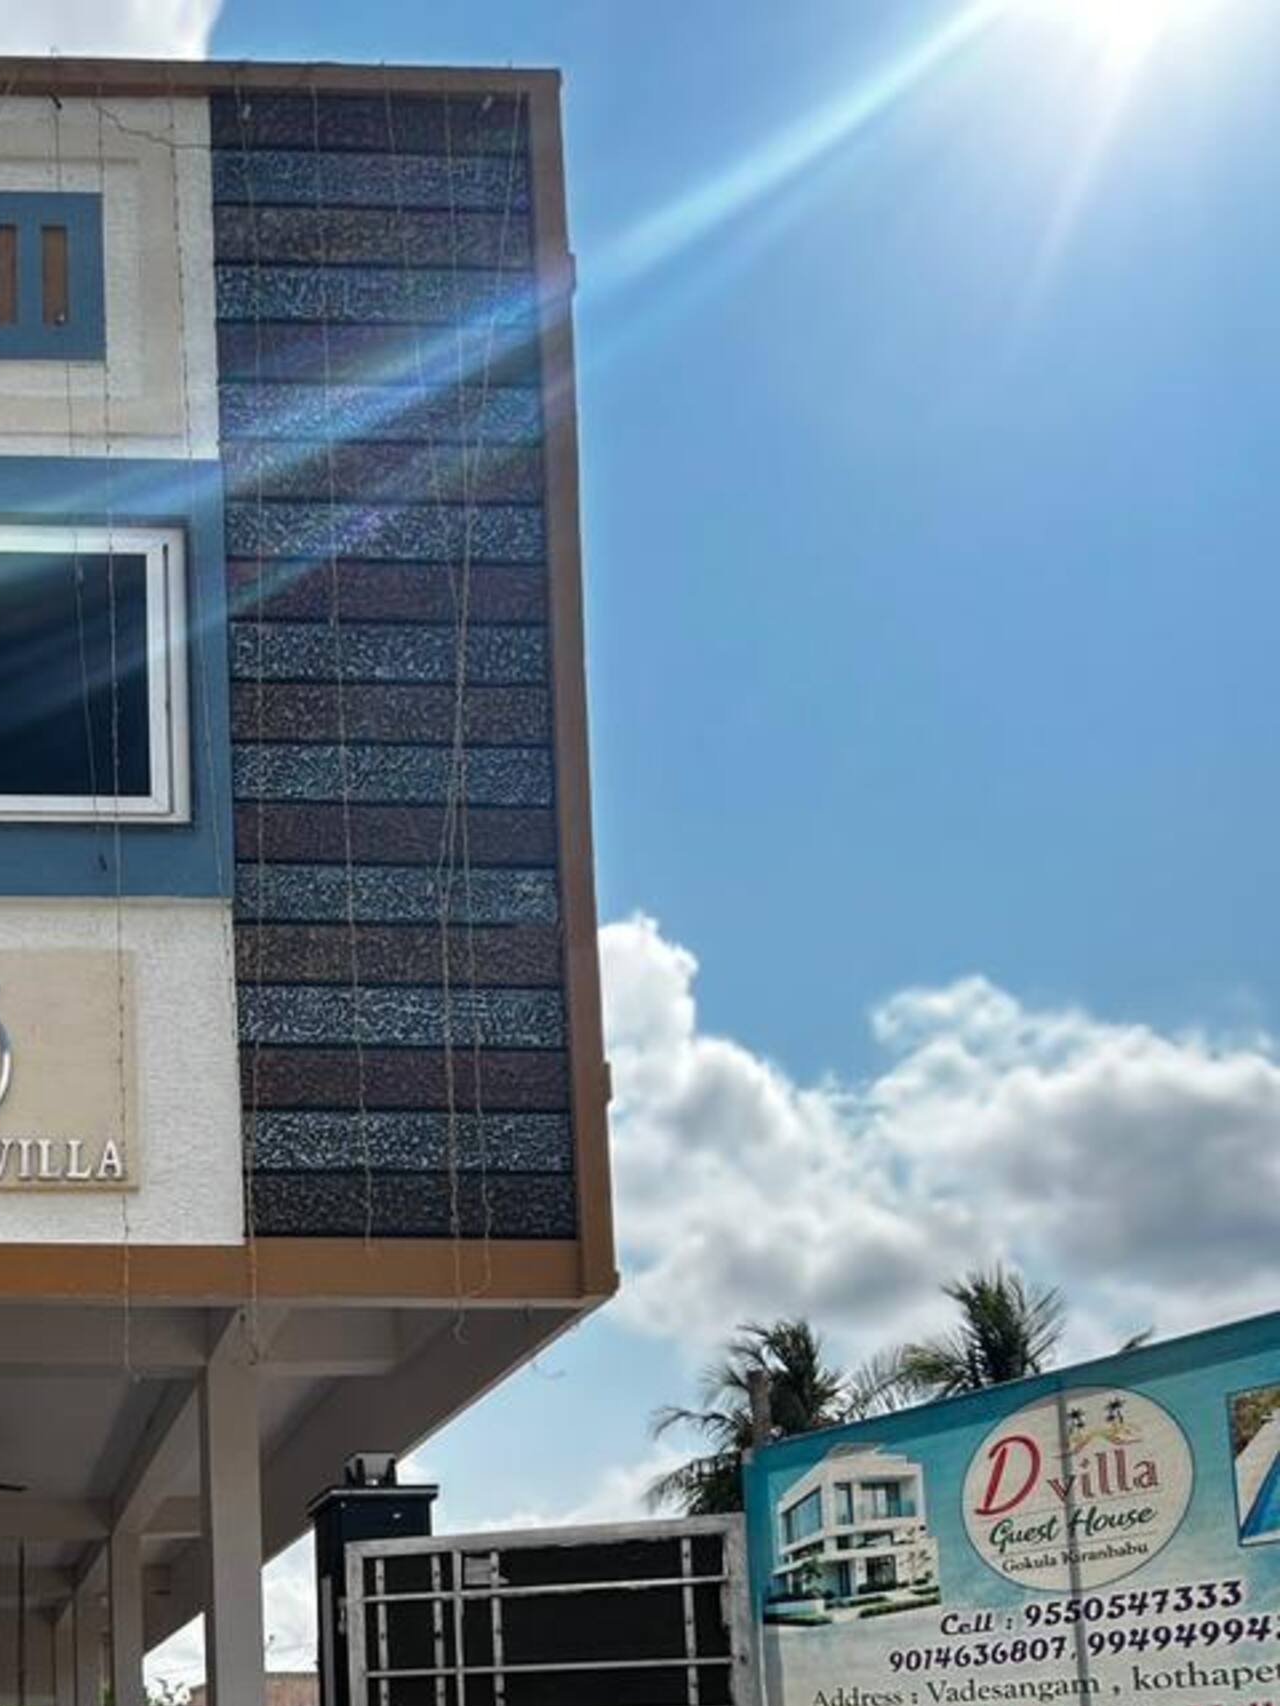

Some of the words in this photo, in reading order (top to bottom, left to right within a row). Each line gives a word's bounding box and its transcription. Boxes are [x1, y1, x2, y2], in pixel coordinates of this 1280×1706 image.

[974, 1435, 1041, 1515] D
[1047, 1449, 1159, 1501] villa
[989, 1515, 1058, 1554] Guest
[1068, 1506, 1154, 1537] House
[1001, 1552, 1058, 1573] Gokula
[940, 1612, 994, 1636] Cell
[1024, 1579, 1242, 1628] 9550547333
[1087, 1614, 1280, 1657] 99494994
[926, 1676, 1100, 1703] Vadesangam
